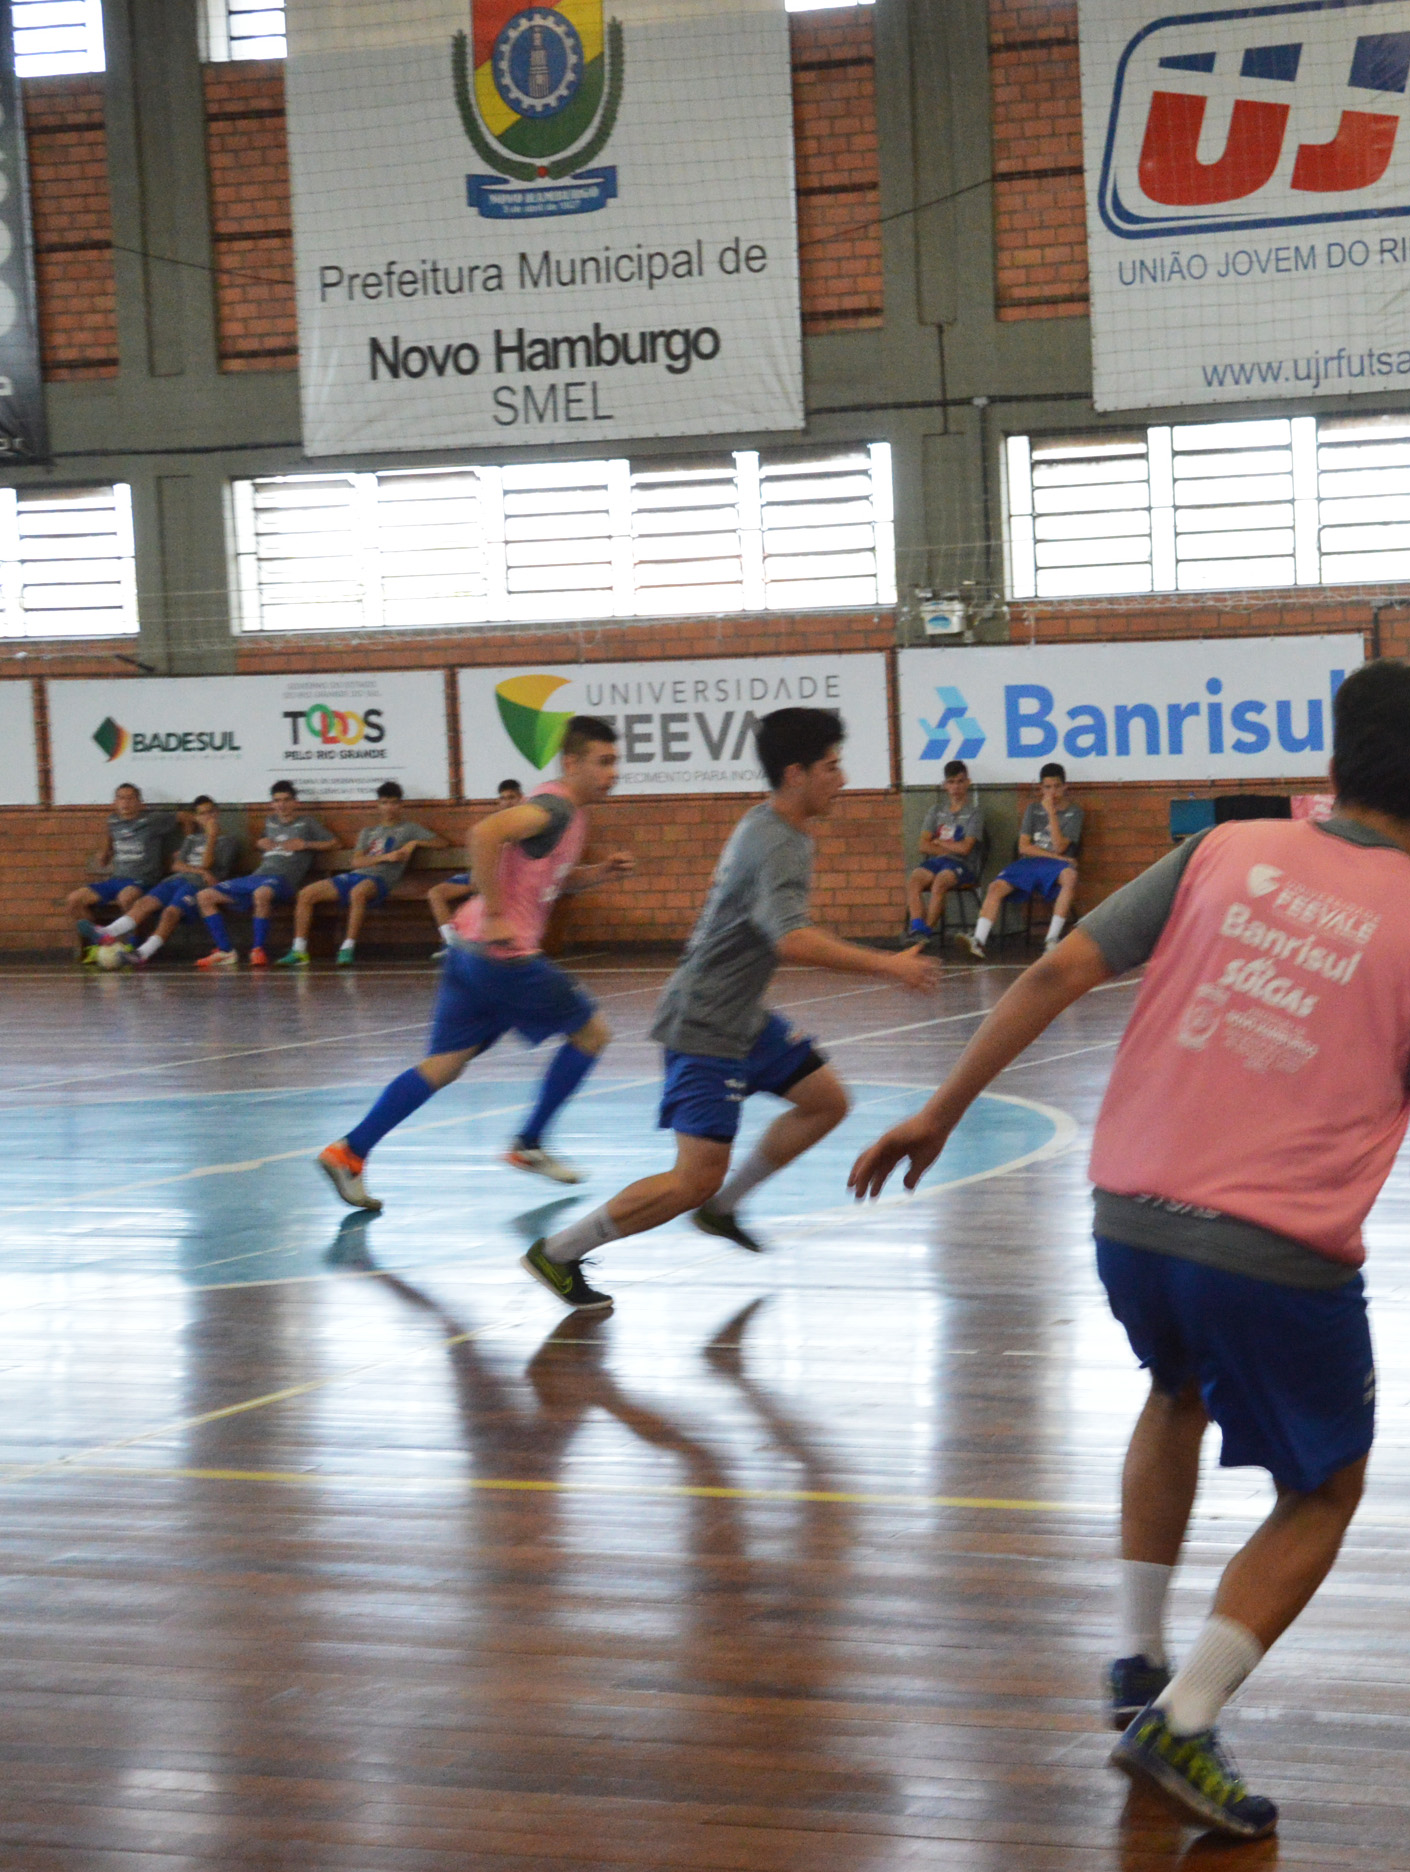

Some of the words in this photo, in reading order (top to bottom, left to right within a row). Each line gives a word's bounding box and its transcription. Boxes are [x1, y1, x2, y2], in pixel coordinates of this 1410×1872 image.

[320, 259, 503, 302] Prefeitura
[519, 239, 703, 290] Municipal
[719, 236, 768, 276] de
[1118, 251, 1207, 286] UNIÃO
[1217, 244, 1317, 278] JOVEM
[1327, 240, 1369, 268] DO
[369, 335, 479, 380] Novo
[493, 322, 721, 375] Hamburgo
[493, 381, 614, 426] SMEL
[586, 675, 840, 706] UNIVERSIDADE
[132, 731, 241, 753] BADESUL
[283, 704, 386, 745] TODOS
[590, 707, 840, 764] EEVA
[284, 751, 313, 760] PELO
[317, 750, 338, 760] RIO
[340, 749, 388, 759] GRANDE
[1272, 886, 1380, 945] FEEVALE
[1220, 901, 1363, 986] Banrisul
